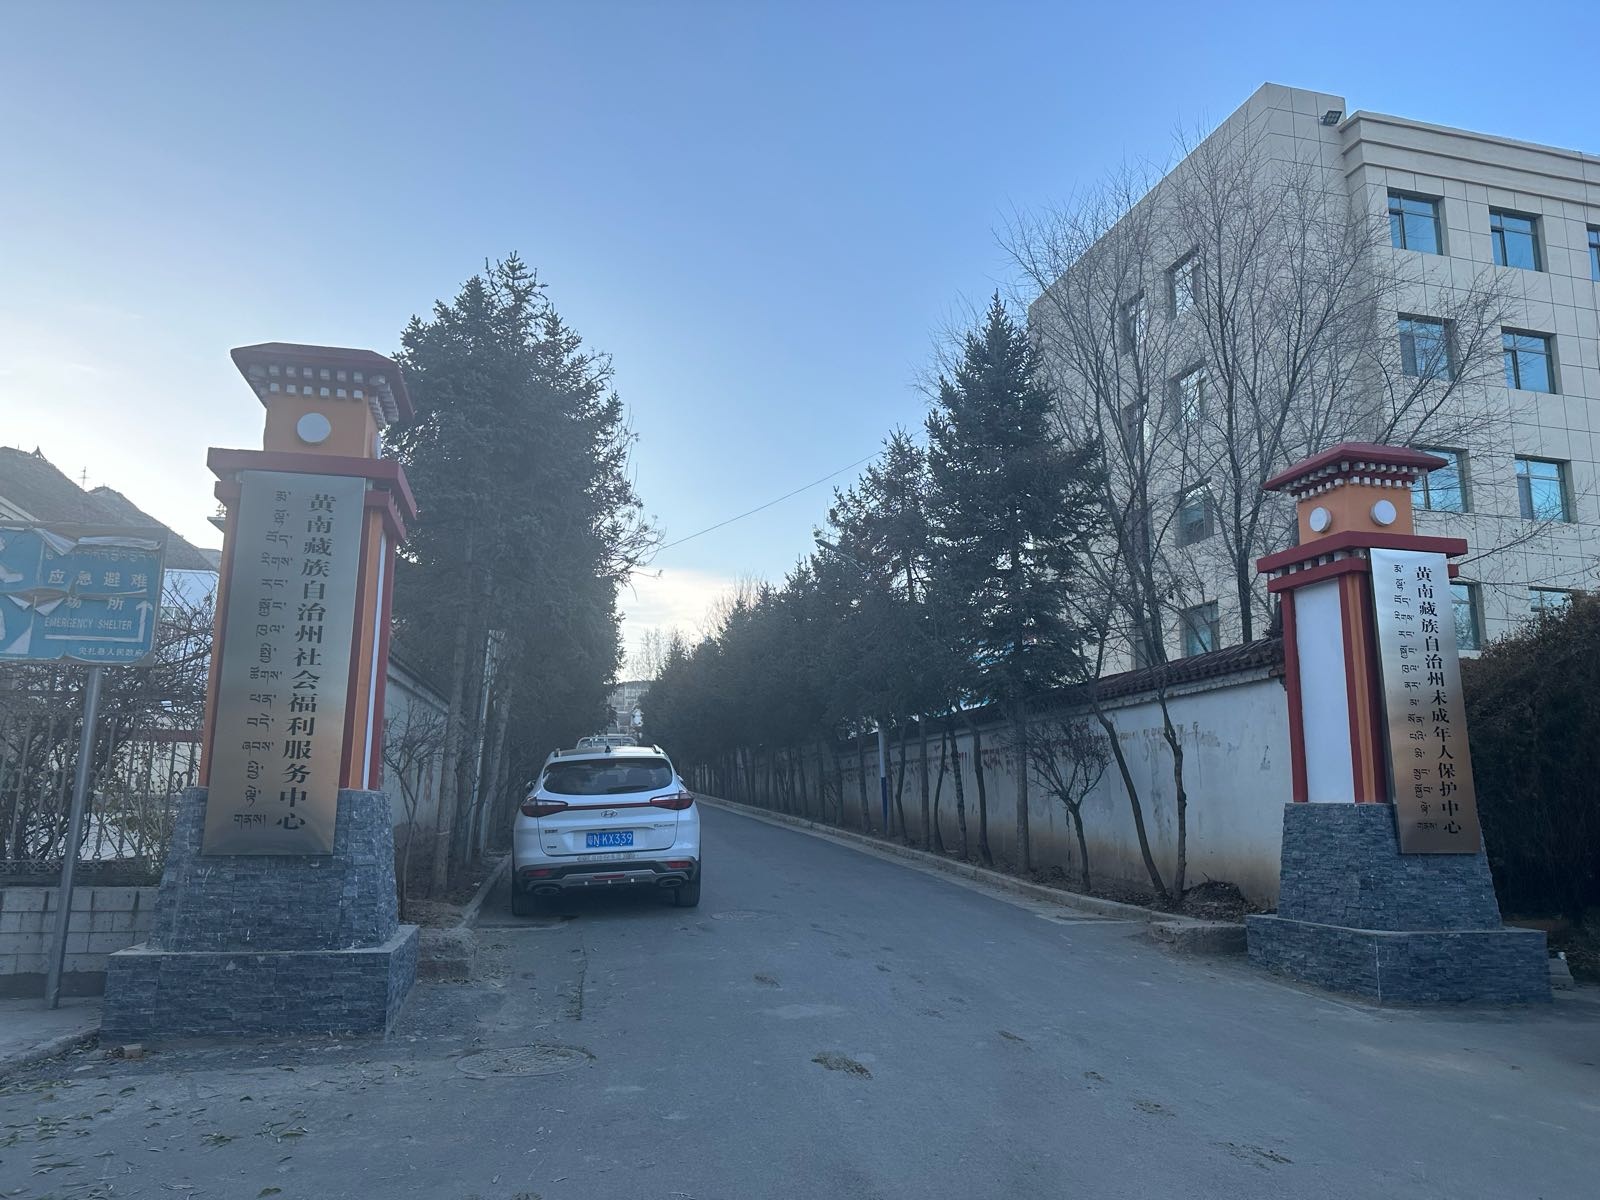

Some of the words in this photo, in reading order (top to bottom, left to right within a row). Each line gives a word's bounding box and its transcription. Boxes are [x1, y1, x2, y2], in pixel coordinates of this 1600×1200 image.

[48, 569, 148, 588] 应急避难
[65, 596, 124, 611] 场所
[44, 617, 93, 629] EMERGENCY
[97, 619, 132, 630] SHELTER
[276, 494, 337, 830] 黄南藏族自治州社会福利服务中心
[1414, 566, 1462, 835] 黄南藏族自治州未成年人保护中心
